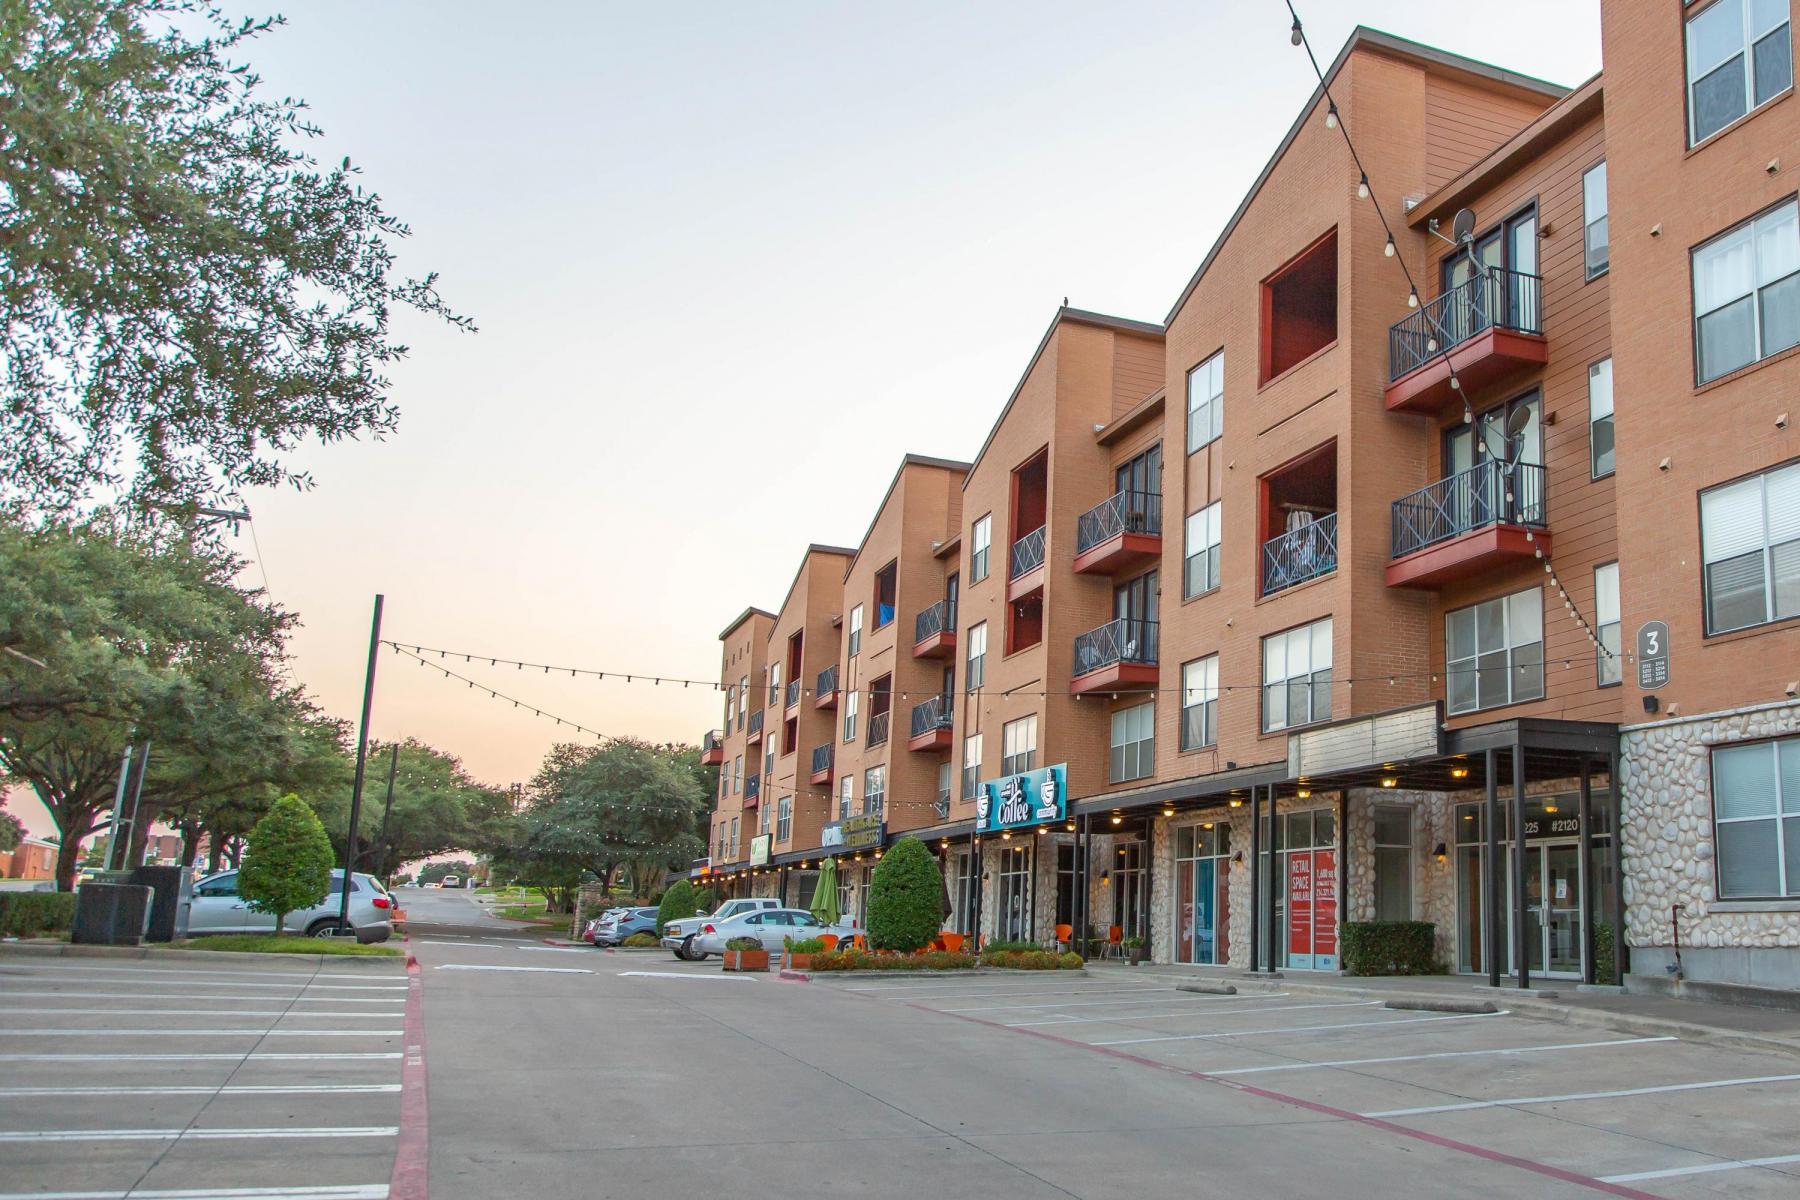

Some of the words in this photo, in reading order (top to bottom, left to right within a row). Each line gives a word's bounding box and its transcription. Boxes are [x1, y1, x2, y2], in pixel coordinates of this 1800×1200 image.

[1646, 630, 1659, 655] 3
[998, 793, 1029, 824] Coffee
[1551, 819, 1578, 832] #2120
[1292, 860, 1309, 873] RETAIL
[1292, 876, 1309, 889] SPACE
